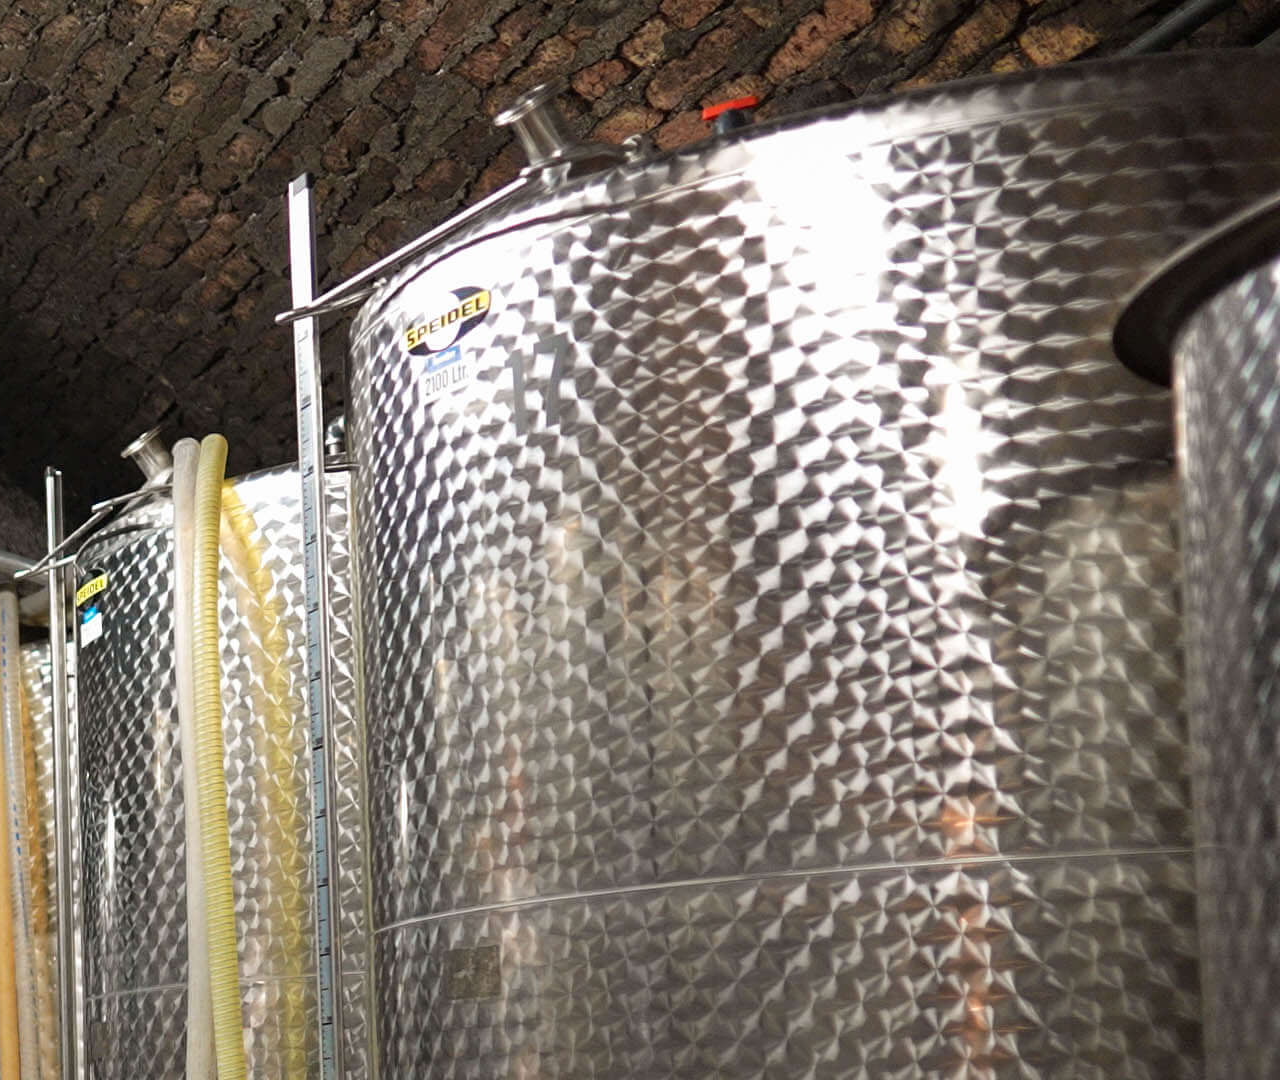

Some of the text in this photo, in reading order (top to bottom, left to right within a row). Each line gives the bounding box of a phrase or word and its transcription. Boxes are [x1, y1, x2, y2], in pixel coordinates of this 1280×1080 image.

[407, 298, 486, 346] SPEIDEL
[425, 370, 450, 397] 2100
[504, 332, 568, 437] 17
